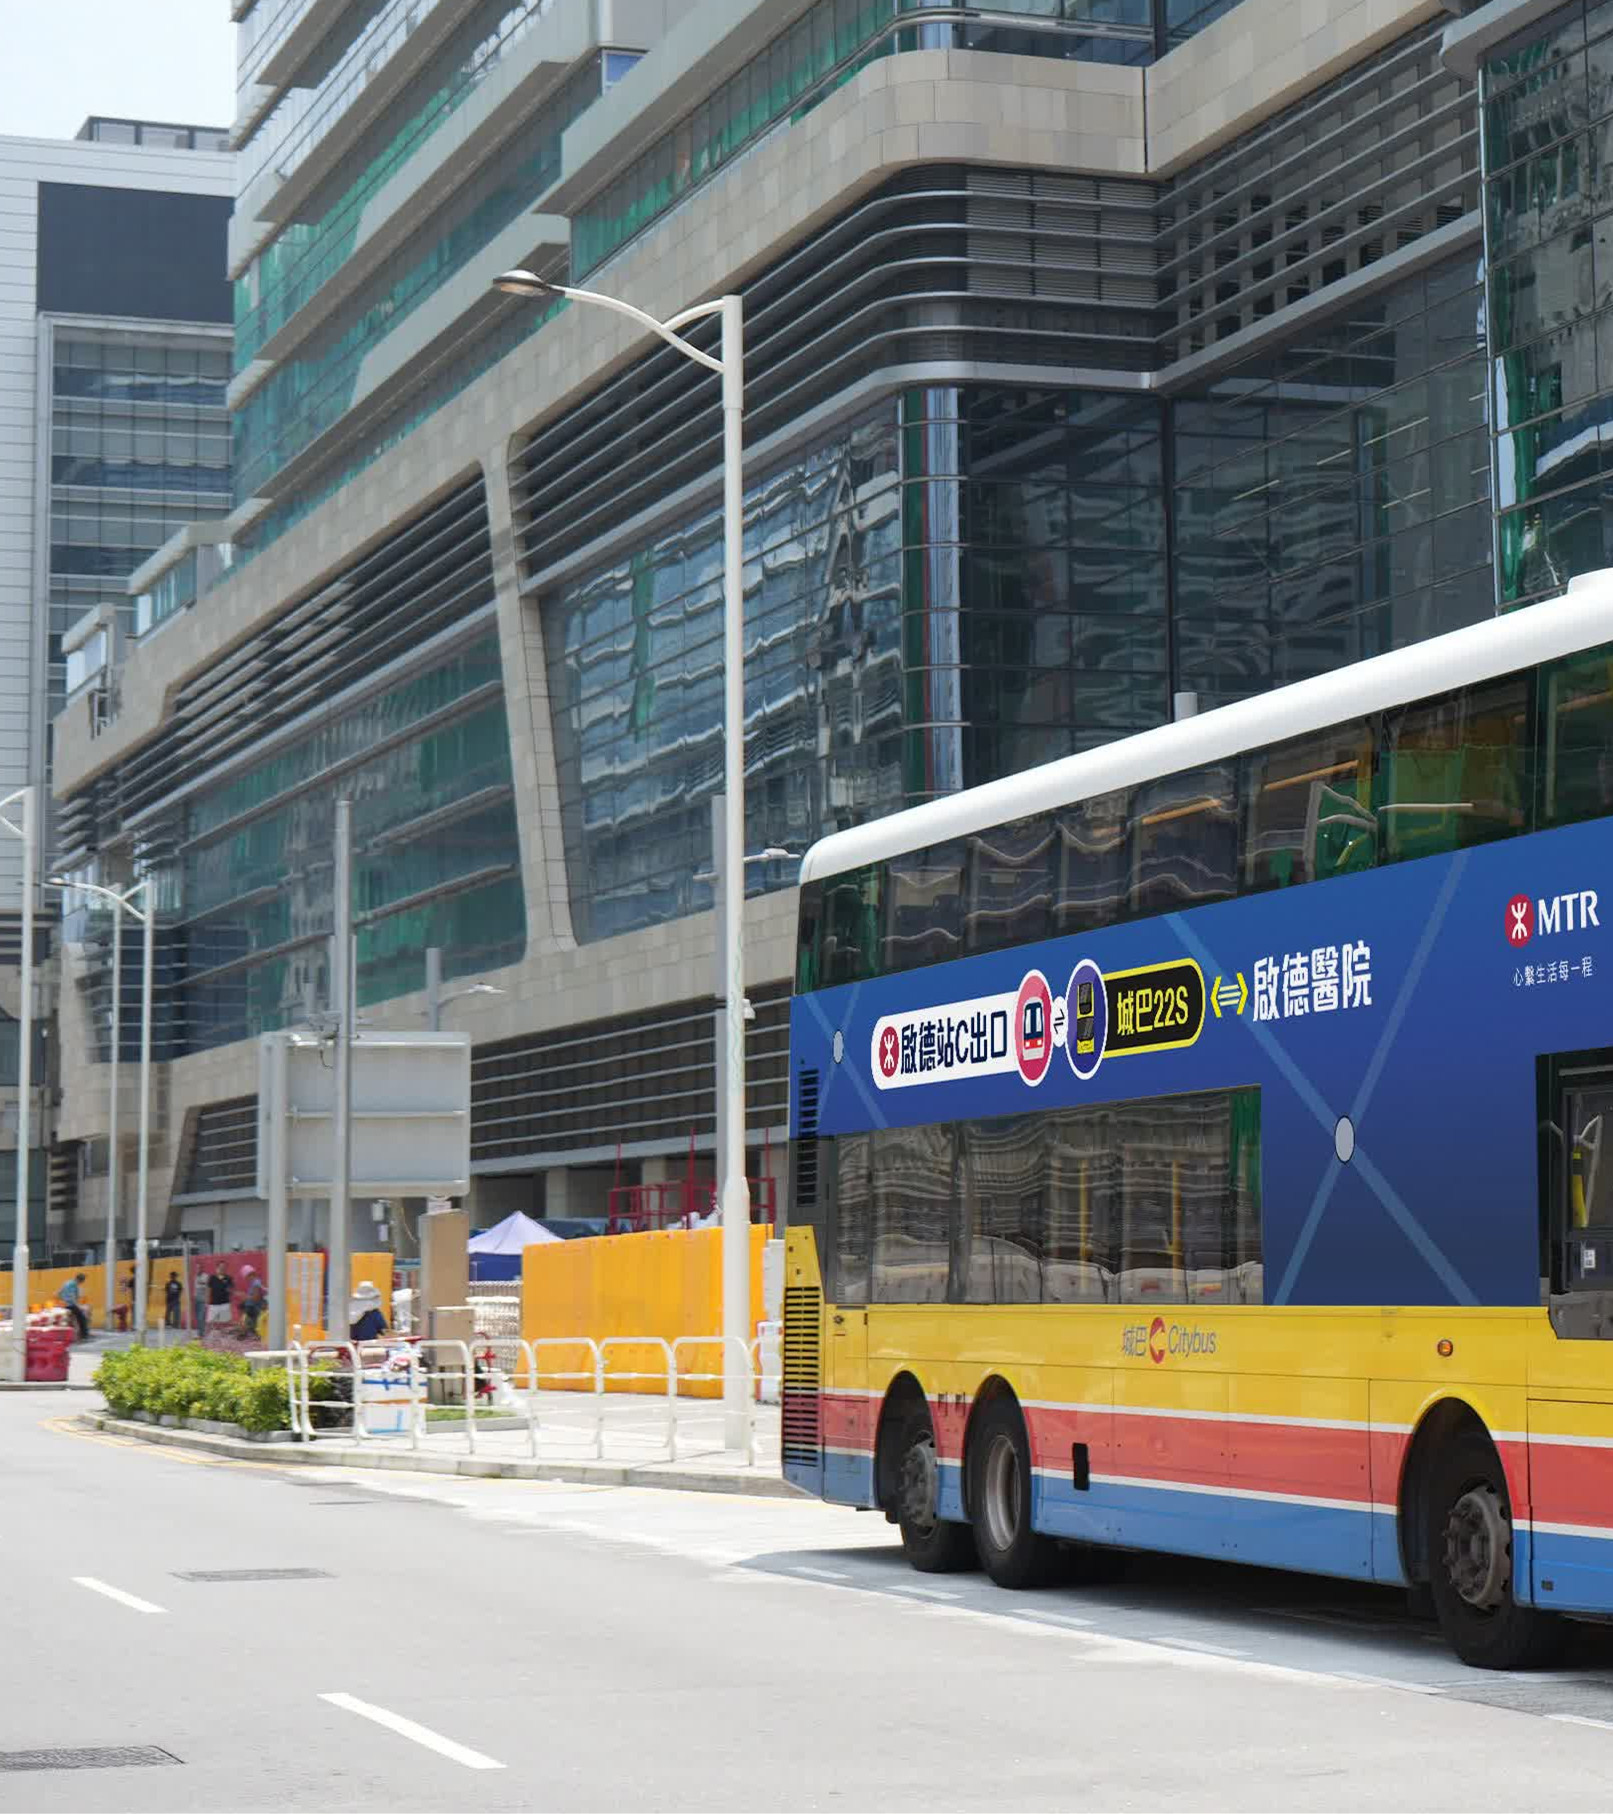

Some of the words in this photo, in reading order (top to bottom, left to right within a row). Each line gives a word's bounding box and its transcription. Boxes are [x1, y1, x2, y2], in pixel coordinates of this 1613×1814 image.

[1538, 890, 1600, 936] MTR
[1117, 986, 1189, 1036] 城巴22S
[1122, 1325, 1148, 1357] 城巴
[1168, 1325, 1217, 1358] Citybus
